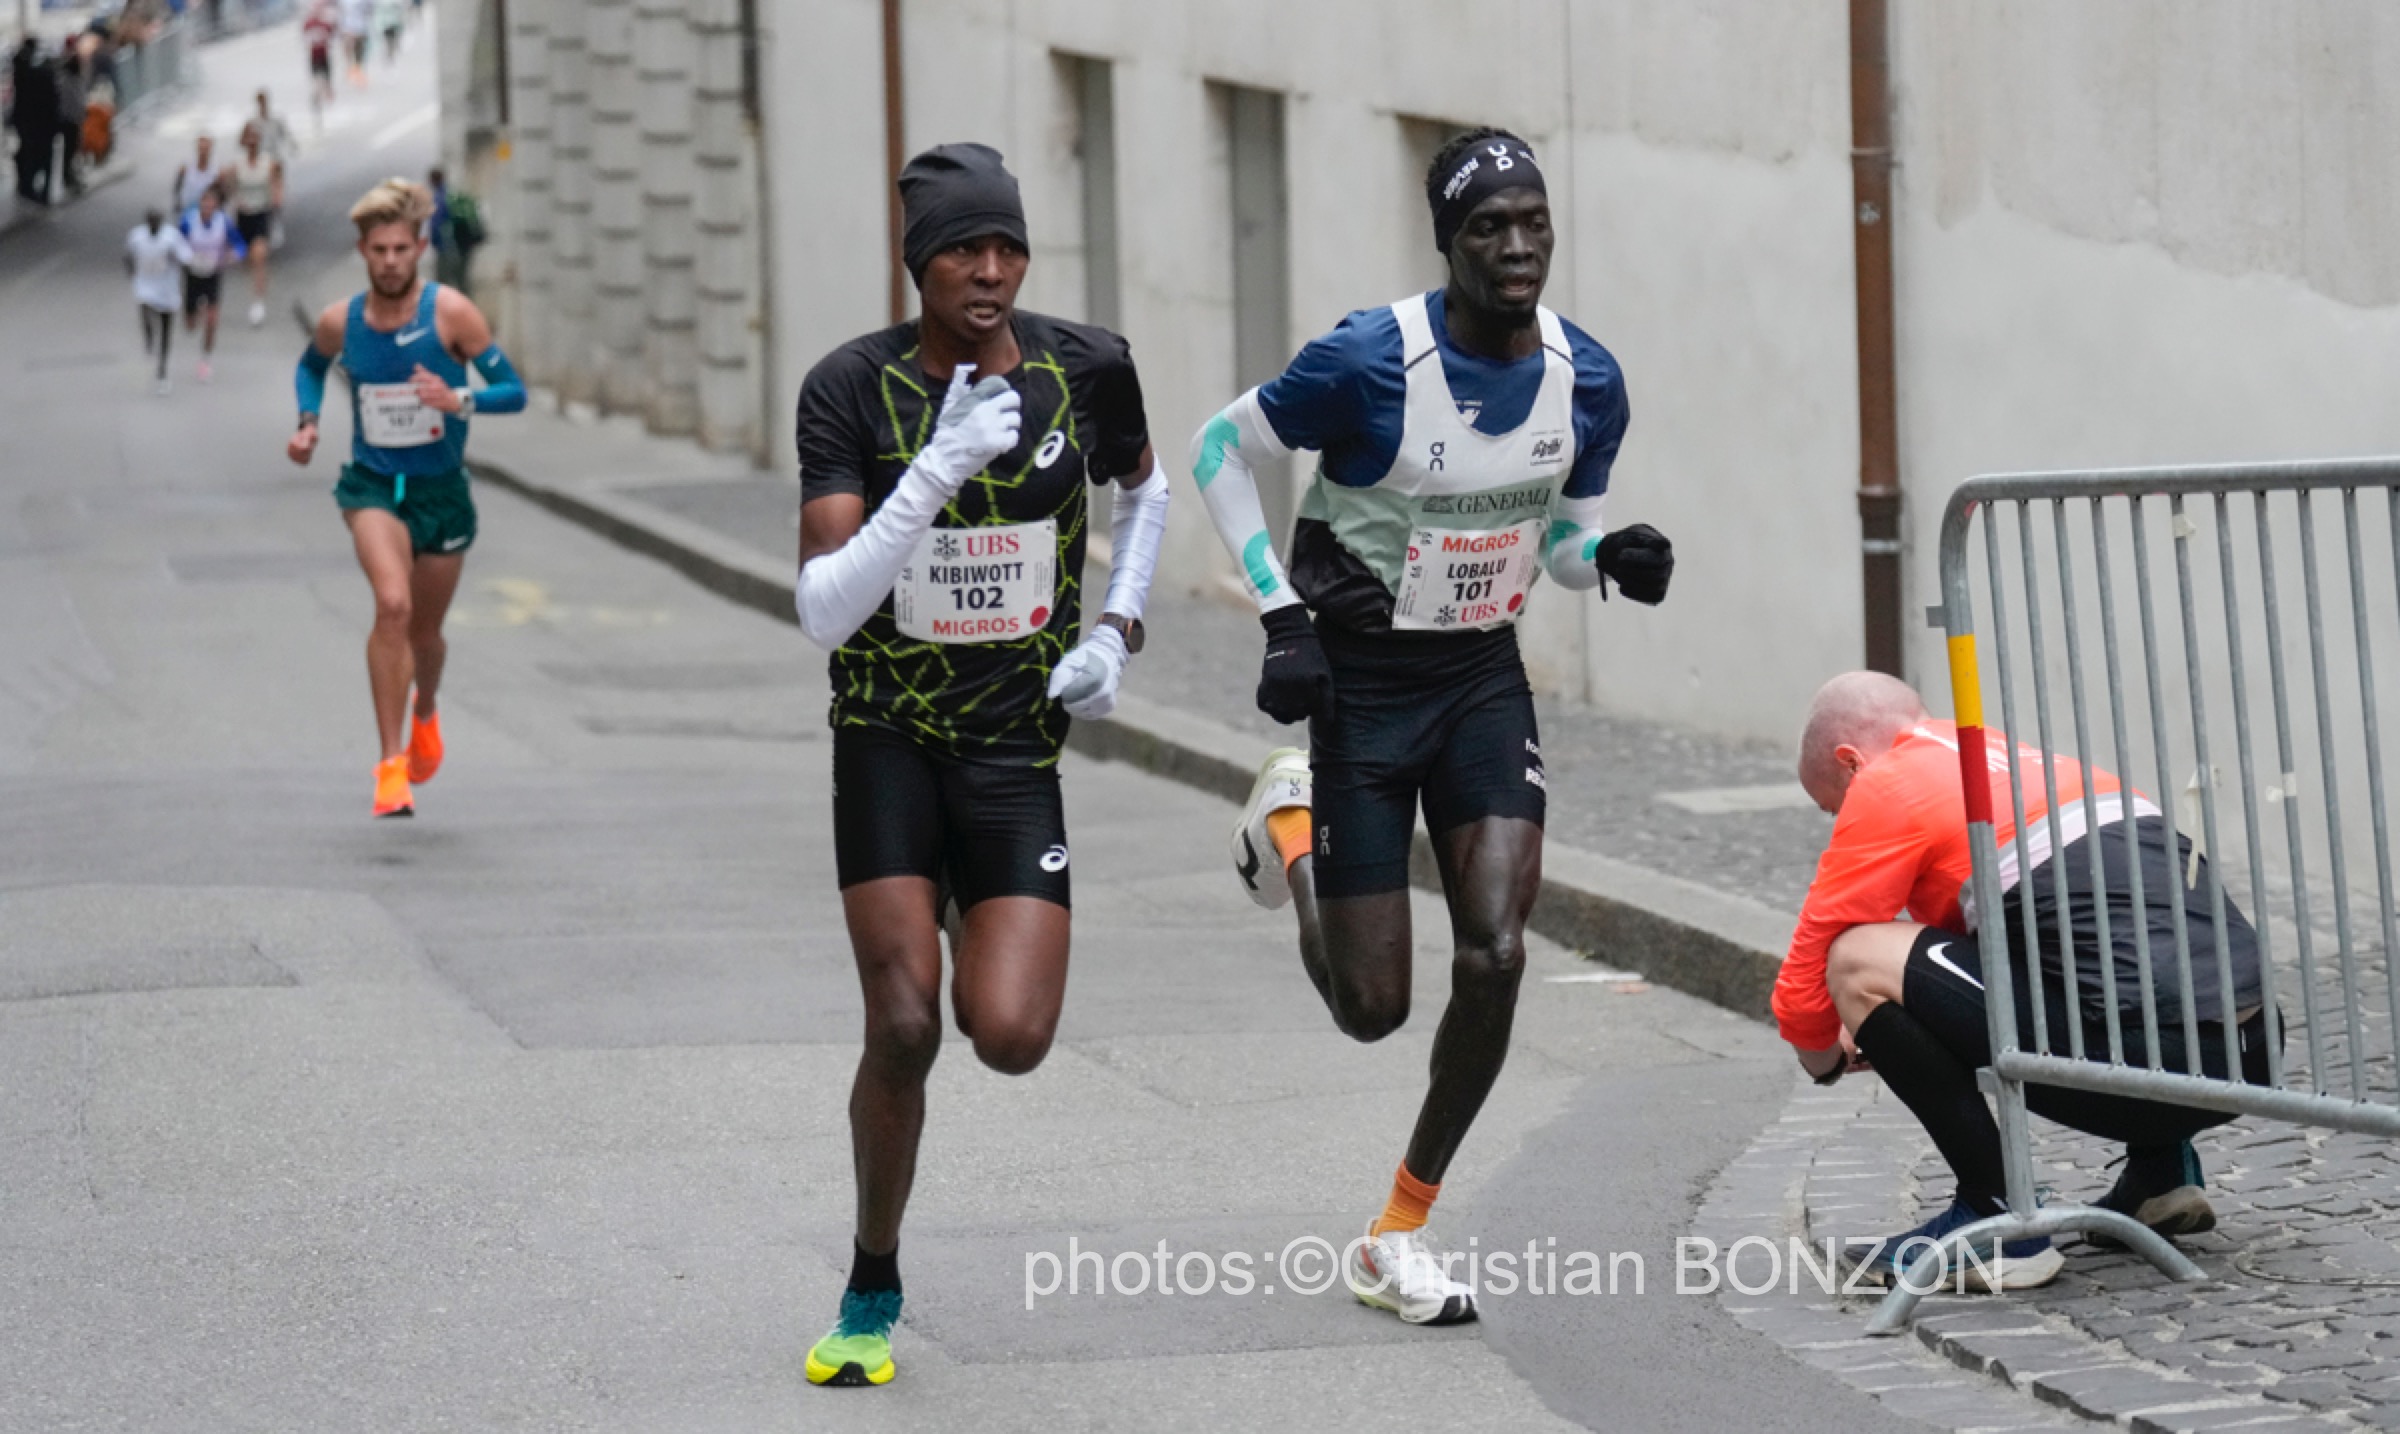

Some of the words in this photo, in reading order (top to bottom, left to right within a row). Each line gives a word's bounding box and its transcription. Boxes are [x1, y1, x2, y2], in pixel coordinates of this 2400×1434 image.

[1457, 488, 1552, 514] GENERALI
[966, 532, 1020, 557] UBS
[1441, 529, 1520, 553] MIGROS
[929, 561, 1024, 585] KIBIWOTT
[1447, 557, 1507, 579] LOBALU
[950, 585, 1005, 610] 102
[1453, 579, 1493, 602] 101
[1461, 601, 1498, 623] UBS
[932, 616, 1020, 636] MIGROS
